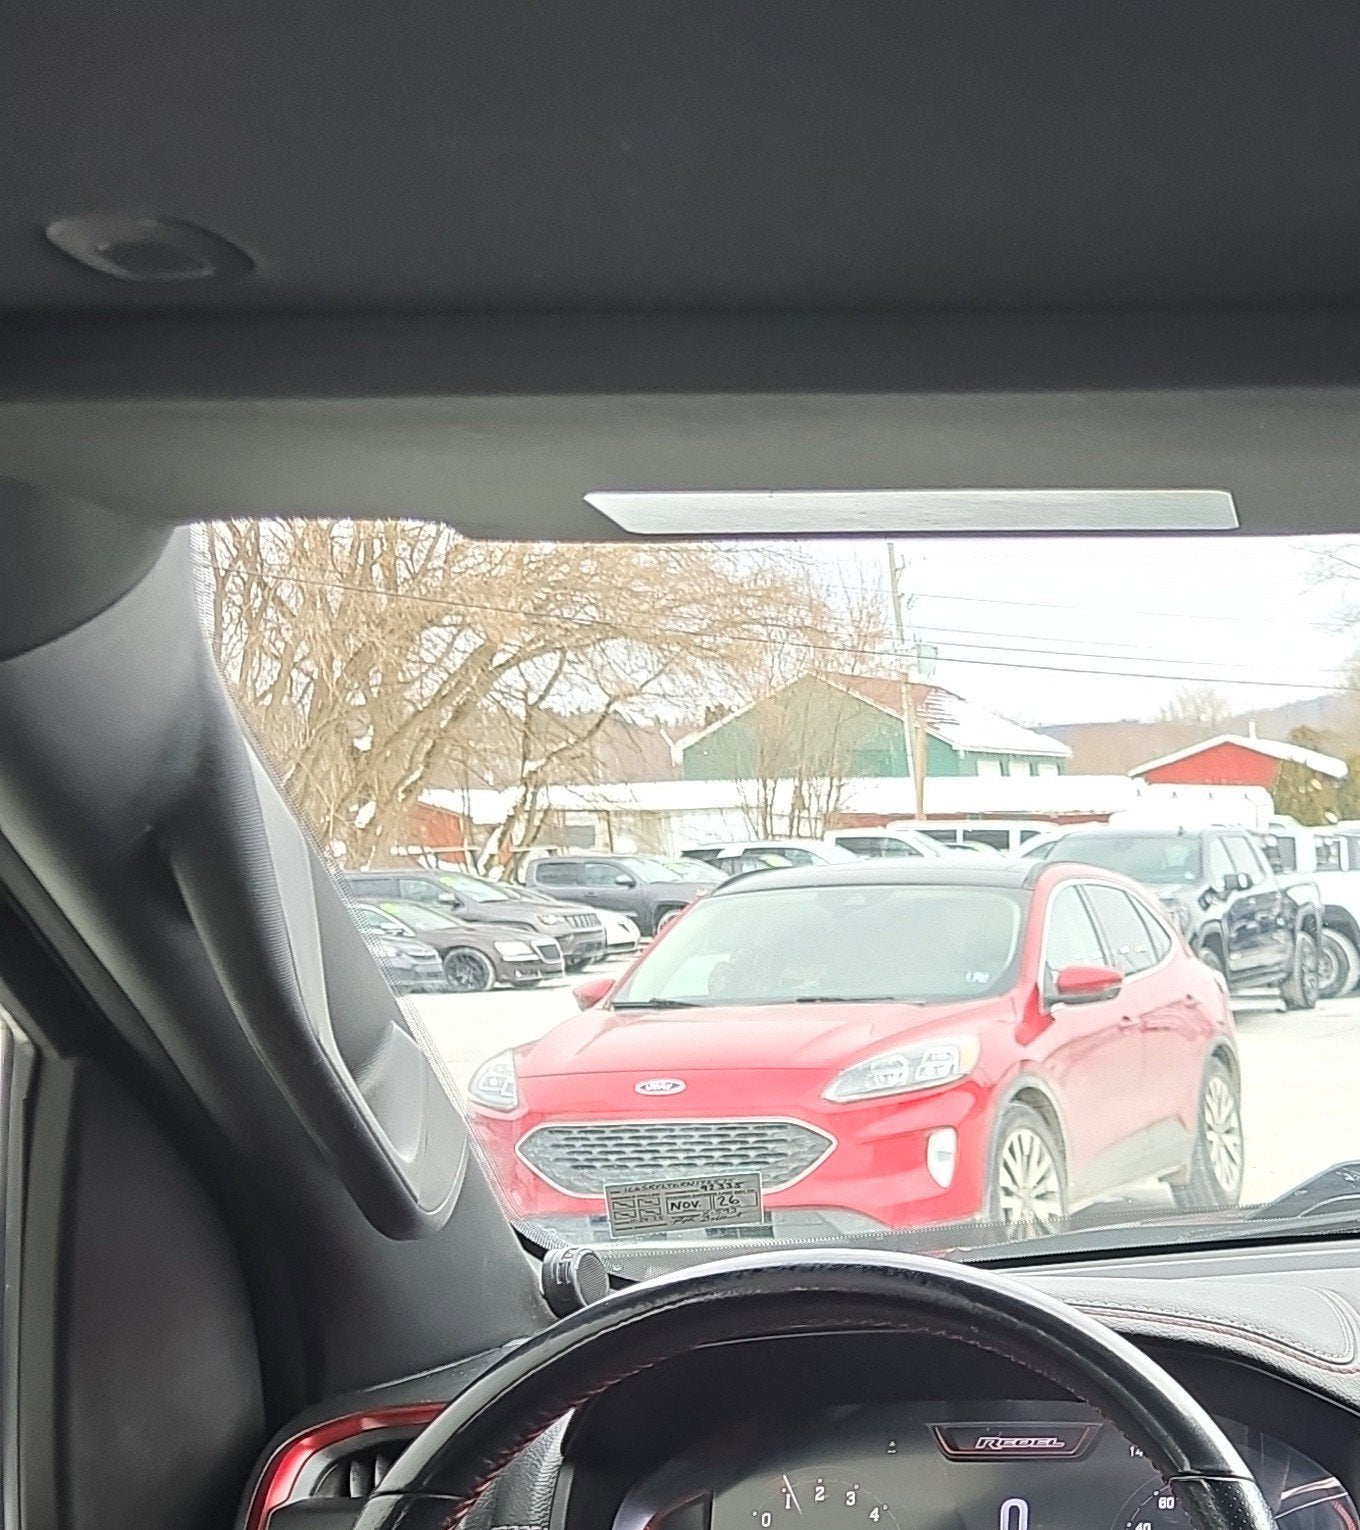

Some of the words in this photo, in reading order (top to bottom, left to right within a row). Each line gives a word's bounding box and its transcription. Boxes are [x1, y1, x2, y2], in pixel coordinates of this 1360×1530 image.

[717, 1195, 740, 1206] 26
[814, 1485, 825, 1501] 2
[846, 1490, 856, 1507] 3
[761, 1511, 772, 1529] 0
[869, 1506, 881, 1523] 4
